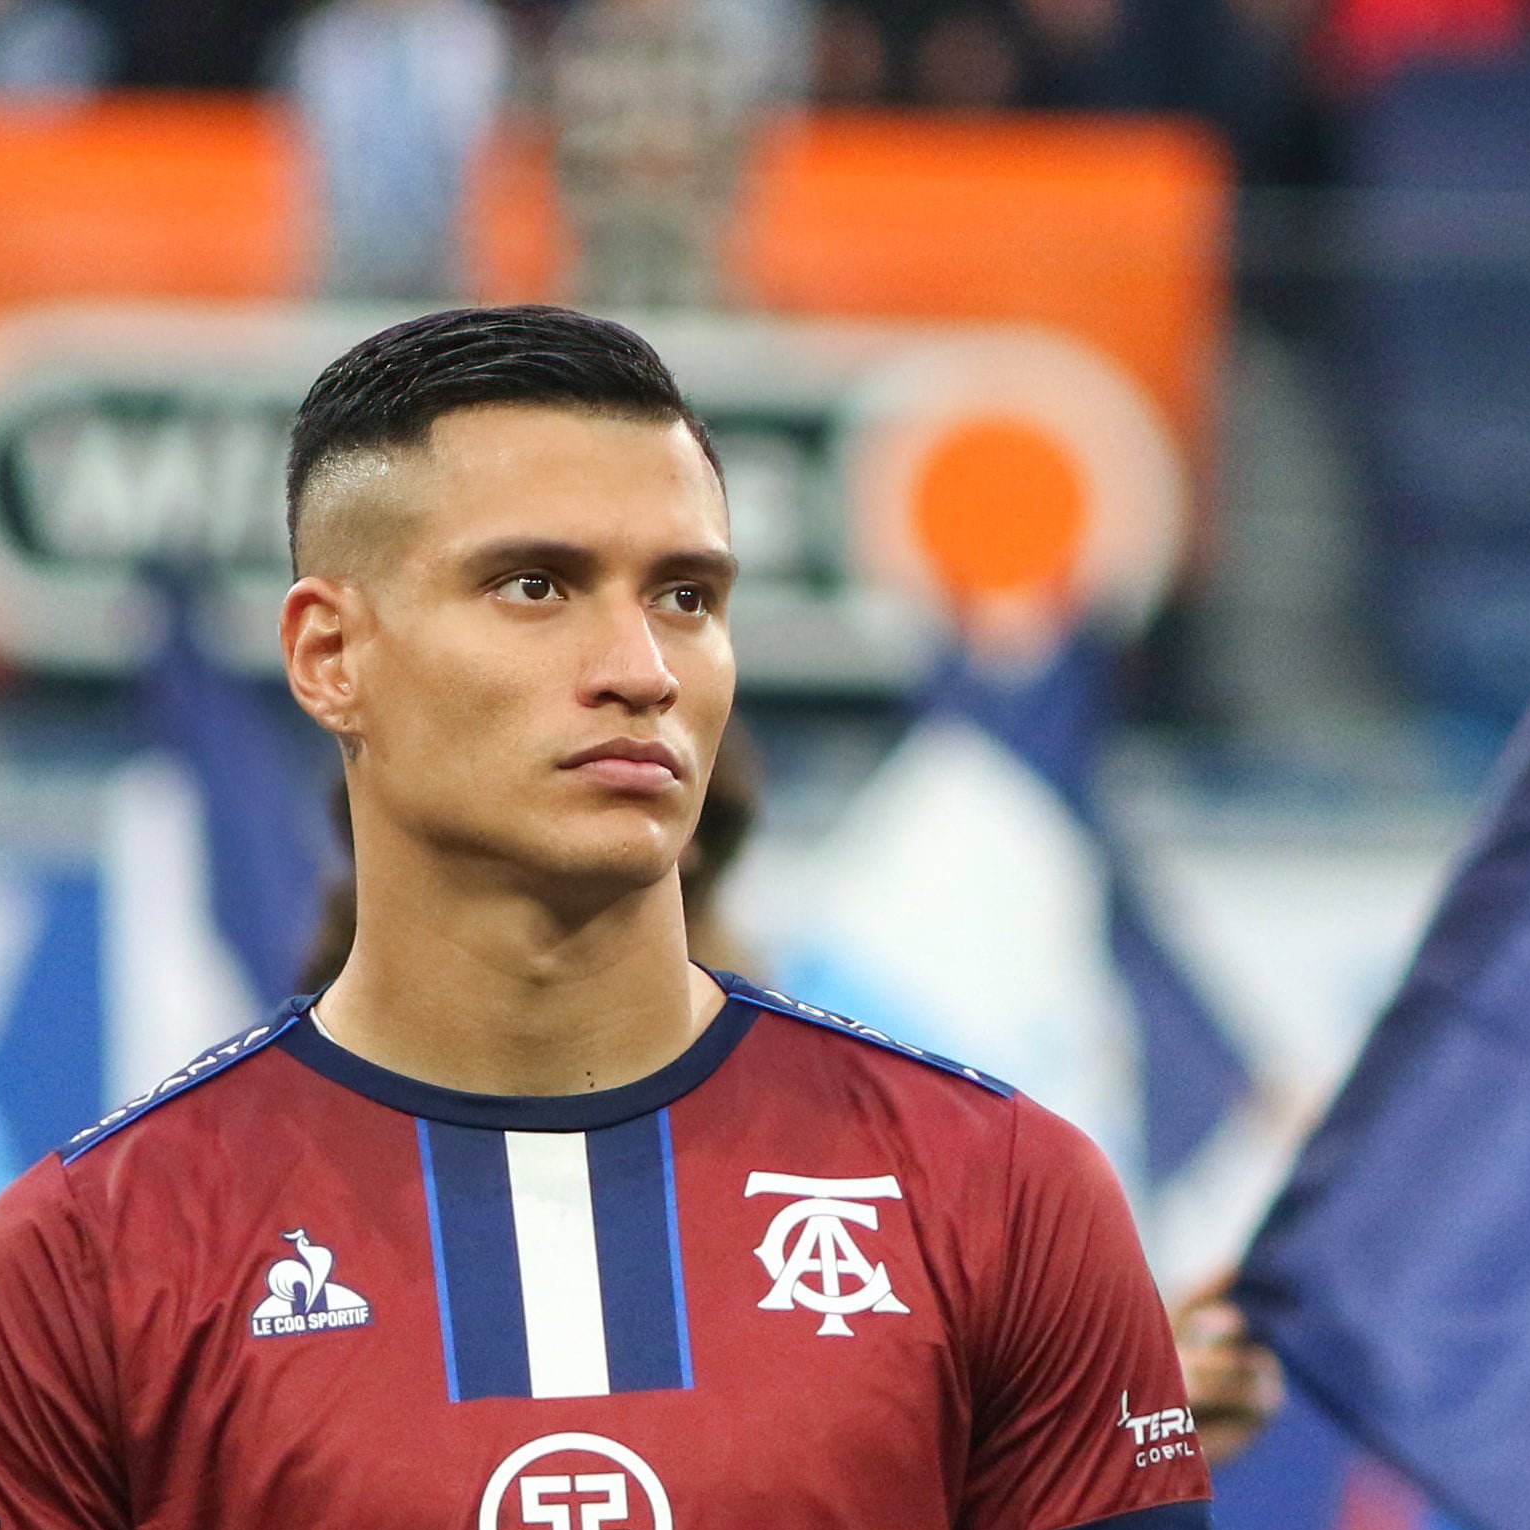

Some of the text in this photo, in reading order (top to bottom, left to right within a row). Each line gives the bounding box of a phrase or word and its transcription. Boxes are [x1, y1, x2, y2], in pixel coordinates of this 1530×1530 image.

[252, 1307, 369, 1336] LE COQ SPORTIF
